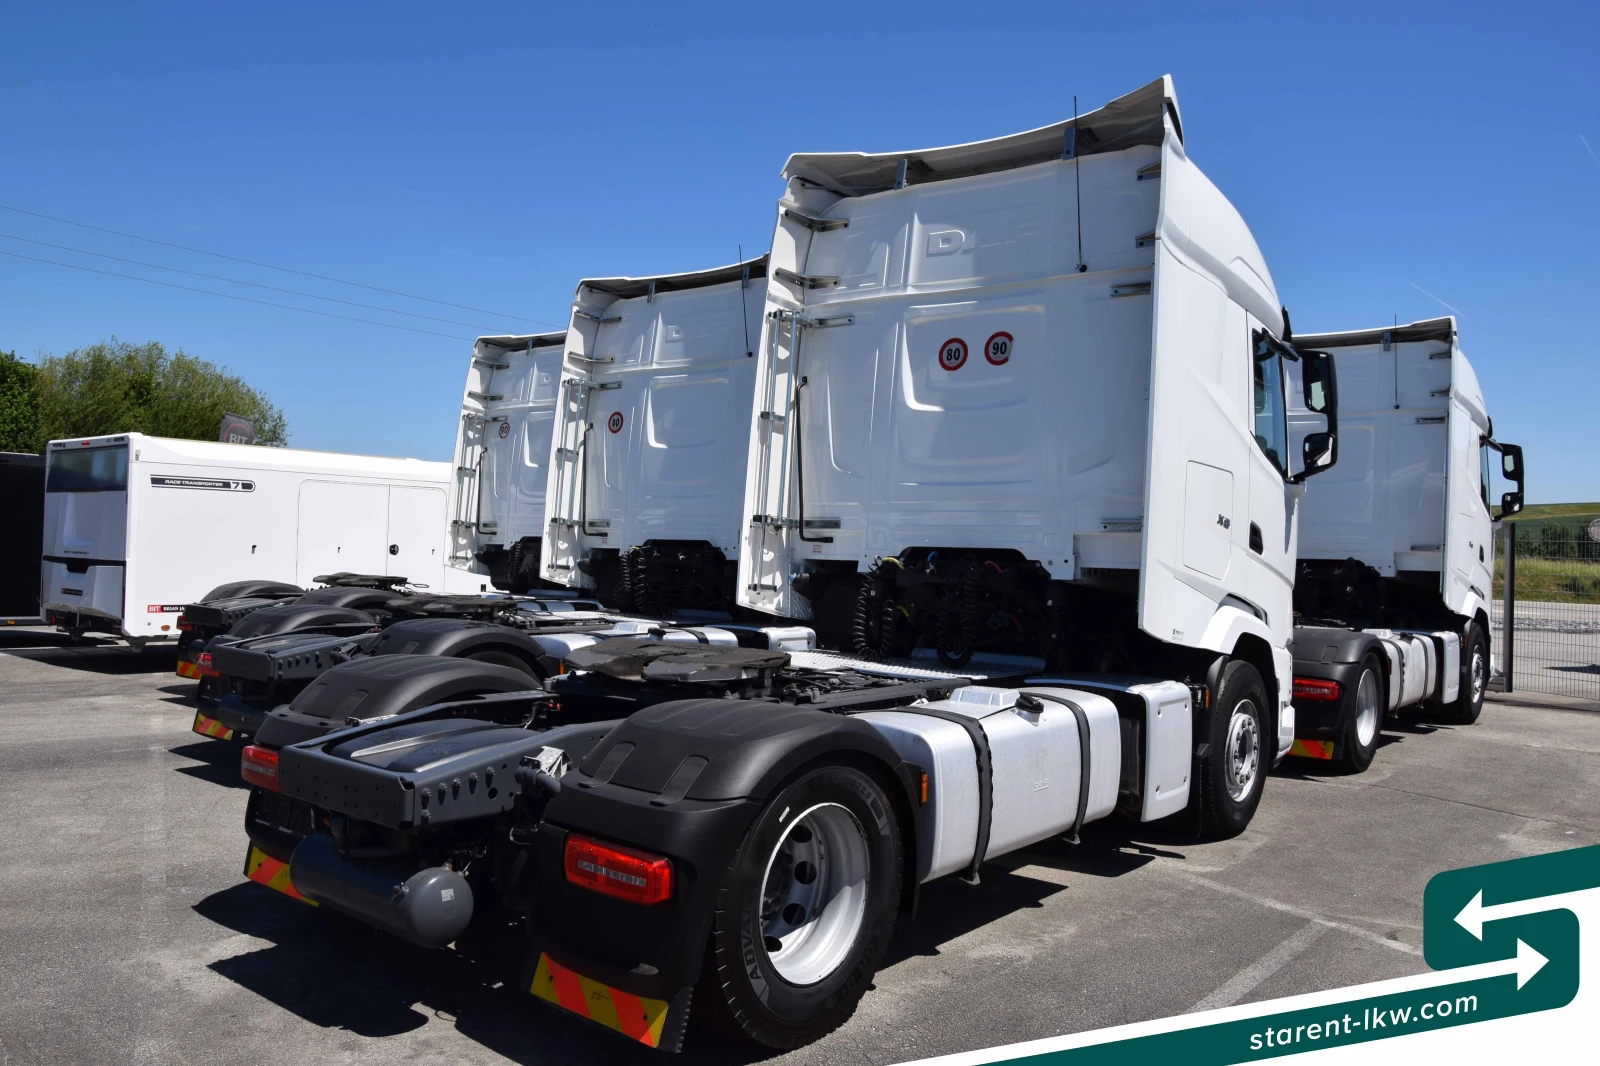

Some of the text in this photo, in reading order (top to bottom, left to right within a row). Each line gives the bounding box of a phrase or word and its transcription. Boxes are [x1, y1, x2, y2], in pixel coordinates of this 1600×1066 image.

[992, 341, 1008, 356] 90
[946, 347, 961, 361] 80
[612, 418, 620, 427] 80
[500, 425, 508, 434] 90
[230, 433, 248, 444] BIT
[232, 481, 240, 489] 7
